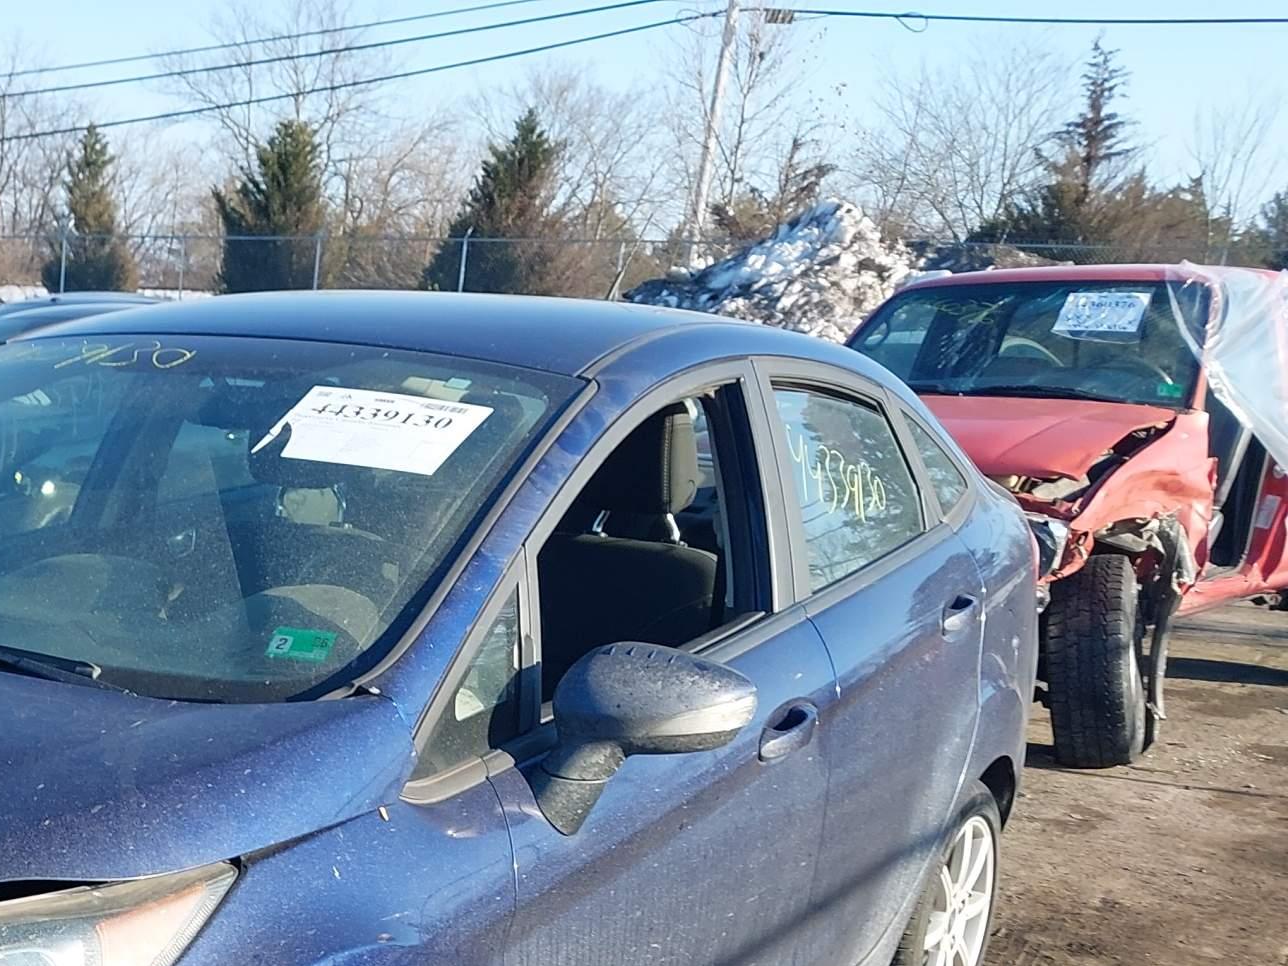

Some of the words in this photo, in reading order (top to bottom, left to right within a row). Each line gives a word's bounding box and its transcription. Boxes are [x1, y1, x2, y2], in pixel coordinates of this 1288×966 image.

[311, 402, 454, 430] 44339130
[784, 423, 887, 523] 44339130
[275, 637, 289, 650] 2
